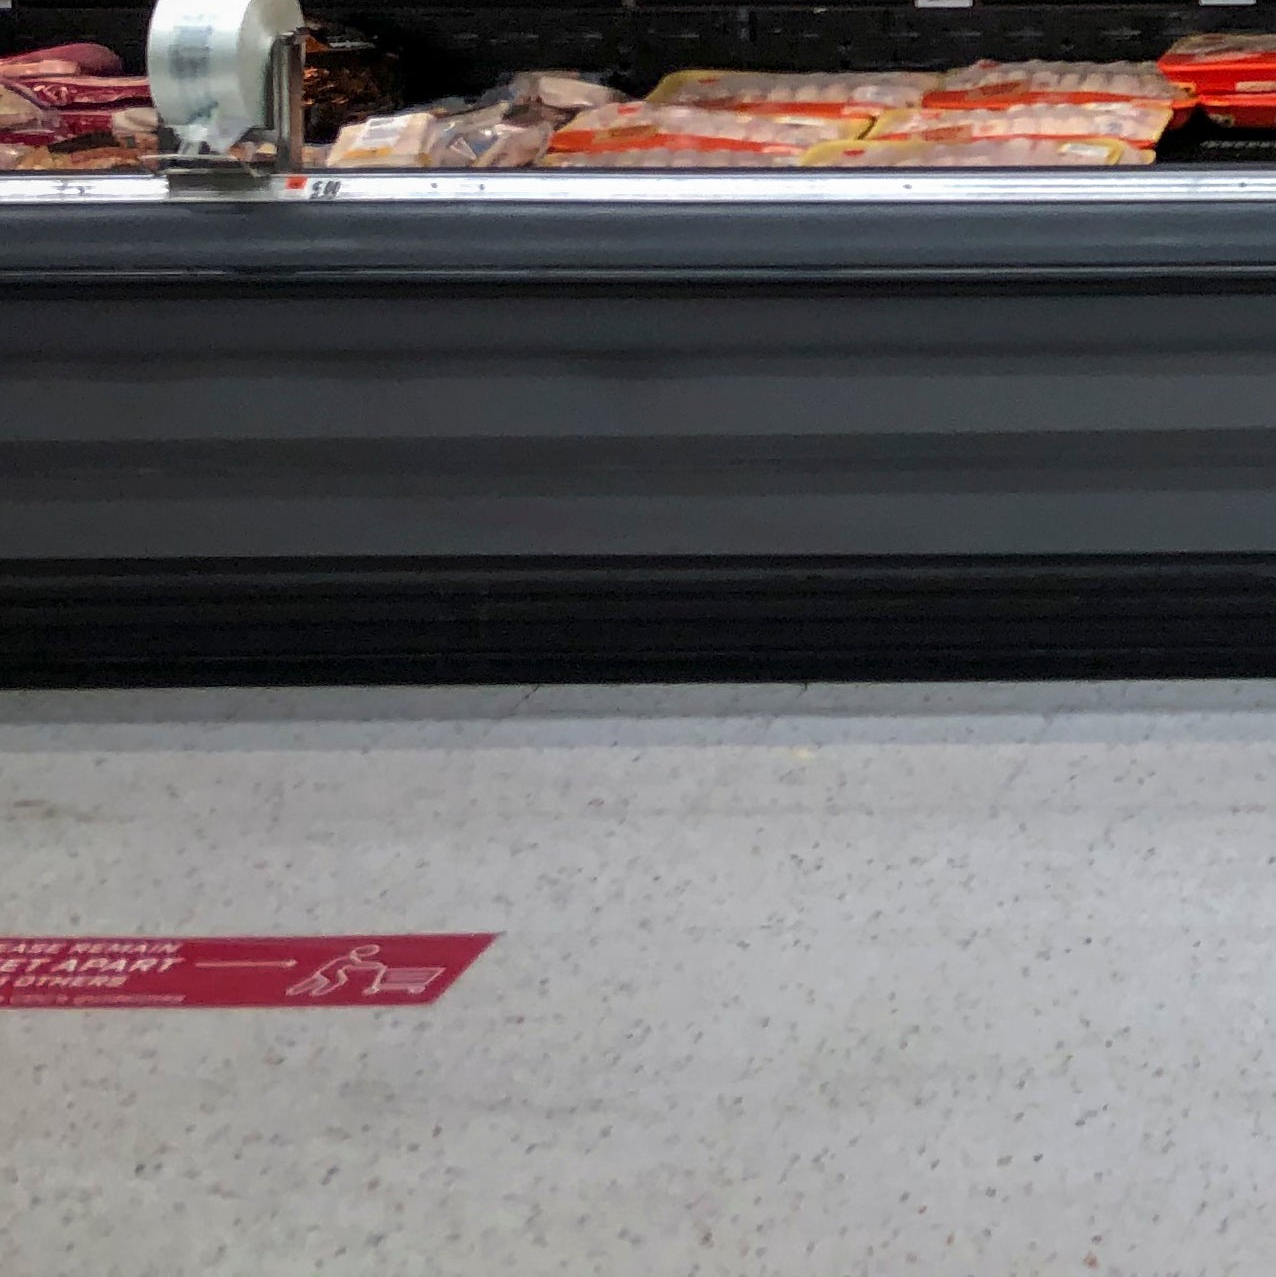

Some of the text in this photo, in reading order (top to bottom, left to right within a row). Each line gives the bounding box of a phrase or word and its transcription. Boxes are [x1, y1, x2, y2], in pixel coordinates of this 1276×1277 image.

[69, 942, 184, 954] REMAIN
[51, 957, 187, 973] APART
[13, 975, 130, 988] OTHERS
